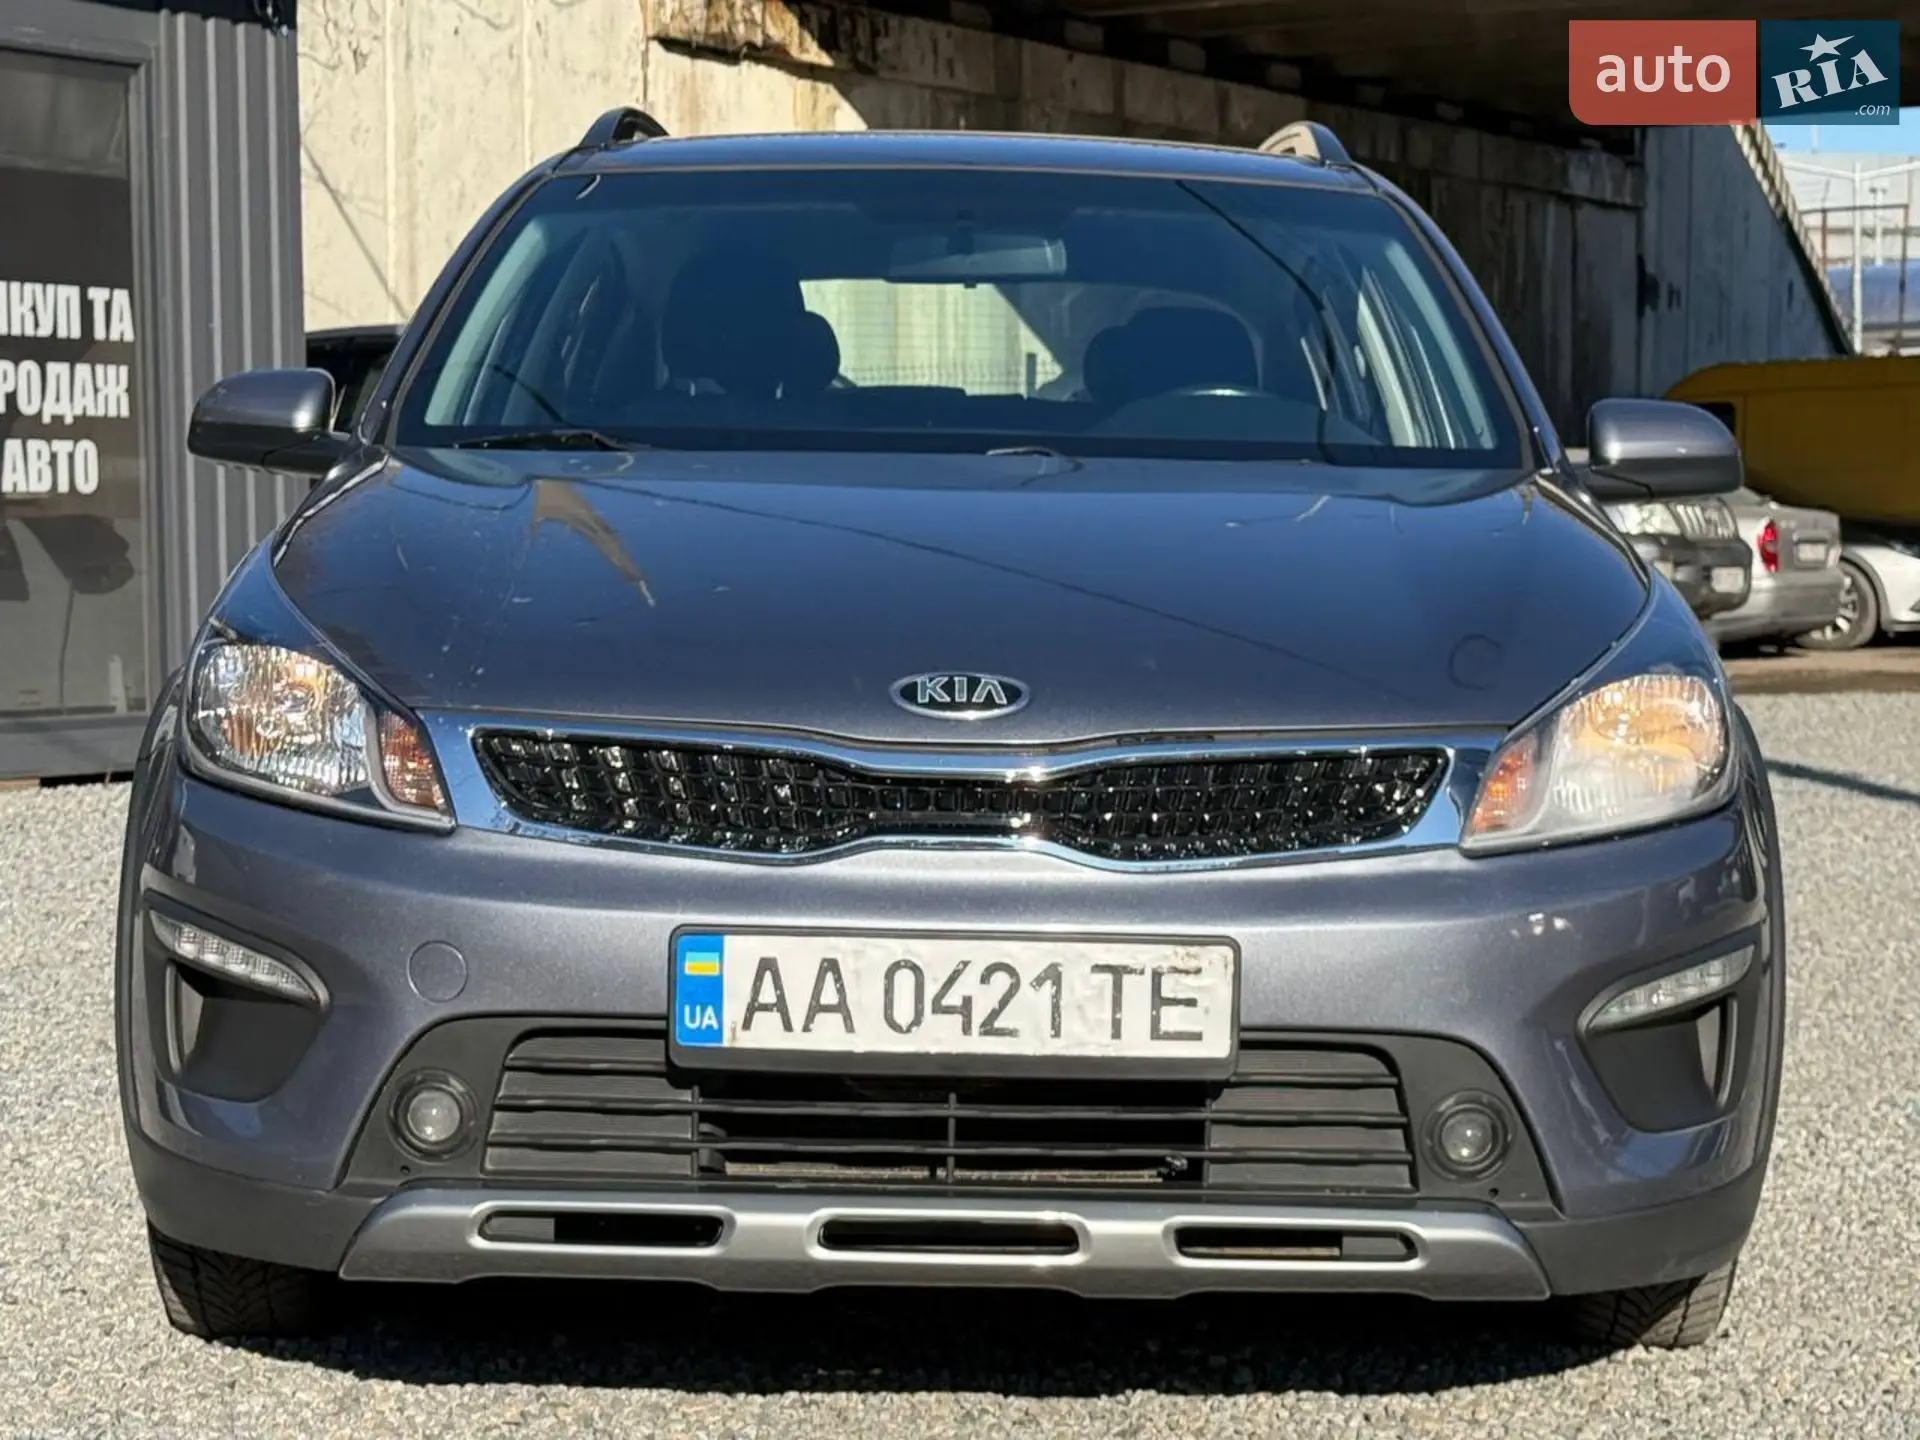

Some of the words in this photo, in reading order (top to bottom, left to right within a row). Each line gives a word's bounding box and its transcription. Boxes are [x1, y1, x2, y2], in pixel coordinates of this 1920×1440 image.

[87, 286, 135, 342] ТА
[2, 438, 99, 494] АВТО
[915, 676, 1008, 705] KIA
[684, 1004, 719, 1030] UA
[741, 956, 856, 1034] AA
[883, 958, 1064, 1039] 0421
[1091, 962, 1204, 1042] TE
